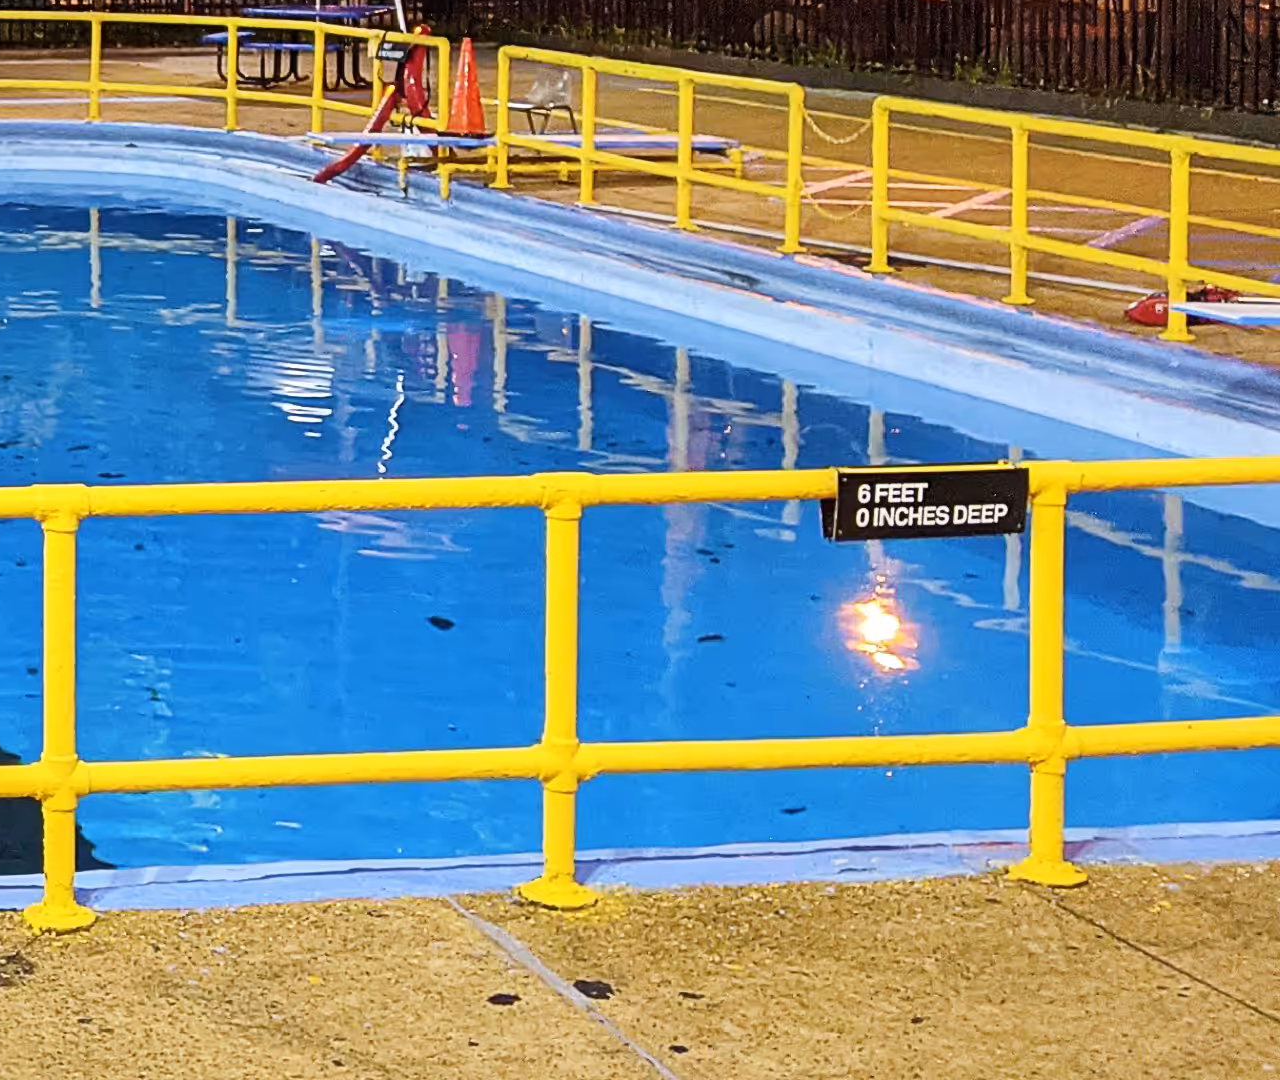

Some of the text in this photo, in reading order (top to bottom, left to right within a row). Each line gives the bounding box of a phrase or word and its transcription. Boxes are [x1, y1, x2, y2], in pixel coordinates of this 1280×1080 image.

[857, 482, 928, 503] 6 FEET
[855, 503, 1008, 527] 0 INCHES DEEP
